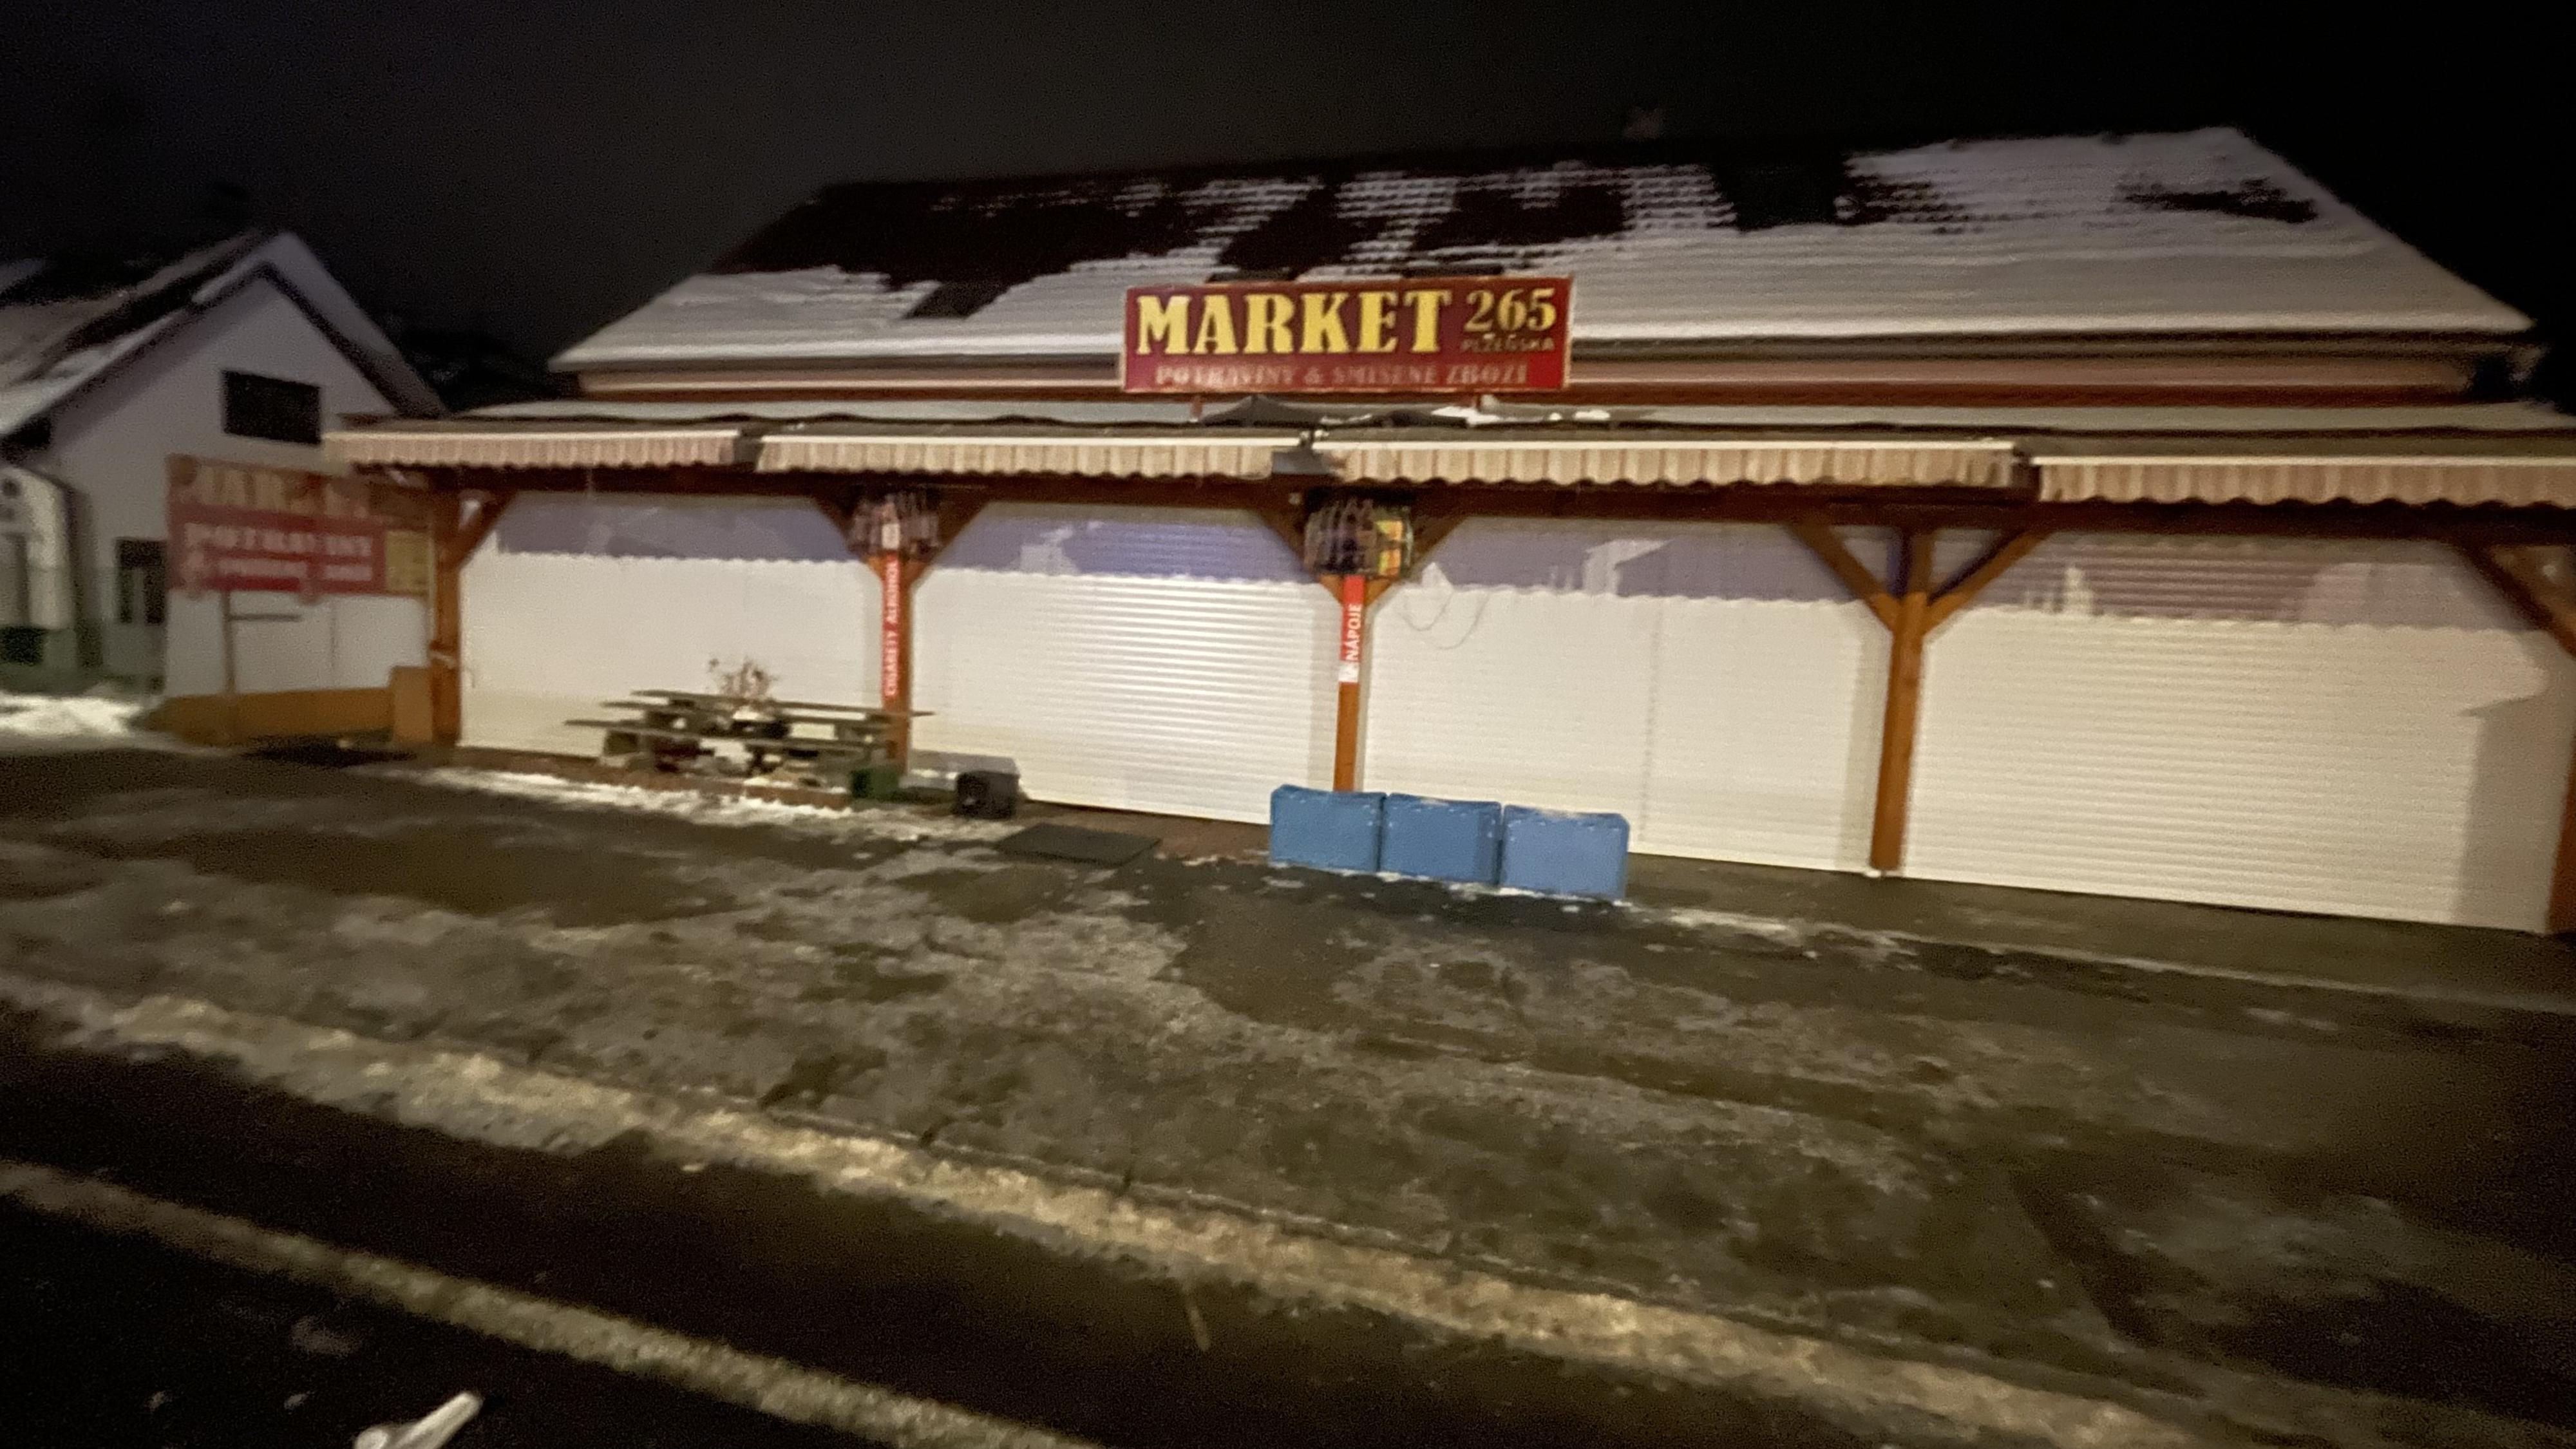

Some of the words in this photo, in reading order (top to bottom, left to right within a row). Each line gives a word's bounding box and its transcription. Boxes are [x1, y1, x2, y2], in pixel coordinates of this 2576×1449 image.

[1136, 289, 1452, 355] MARKET
[1464, 288, 1557, 332] 265
[1343, 603, 1362, 661] NÁPOJE
